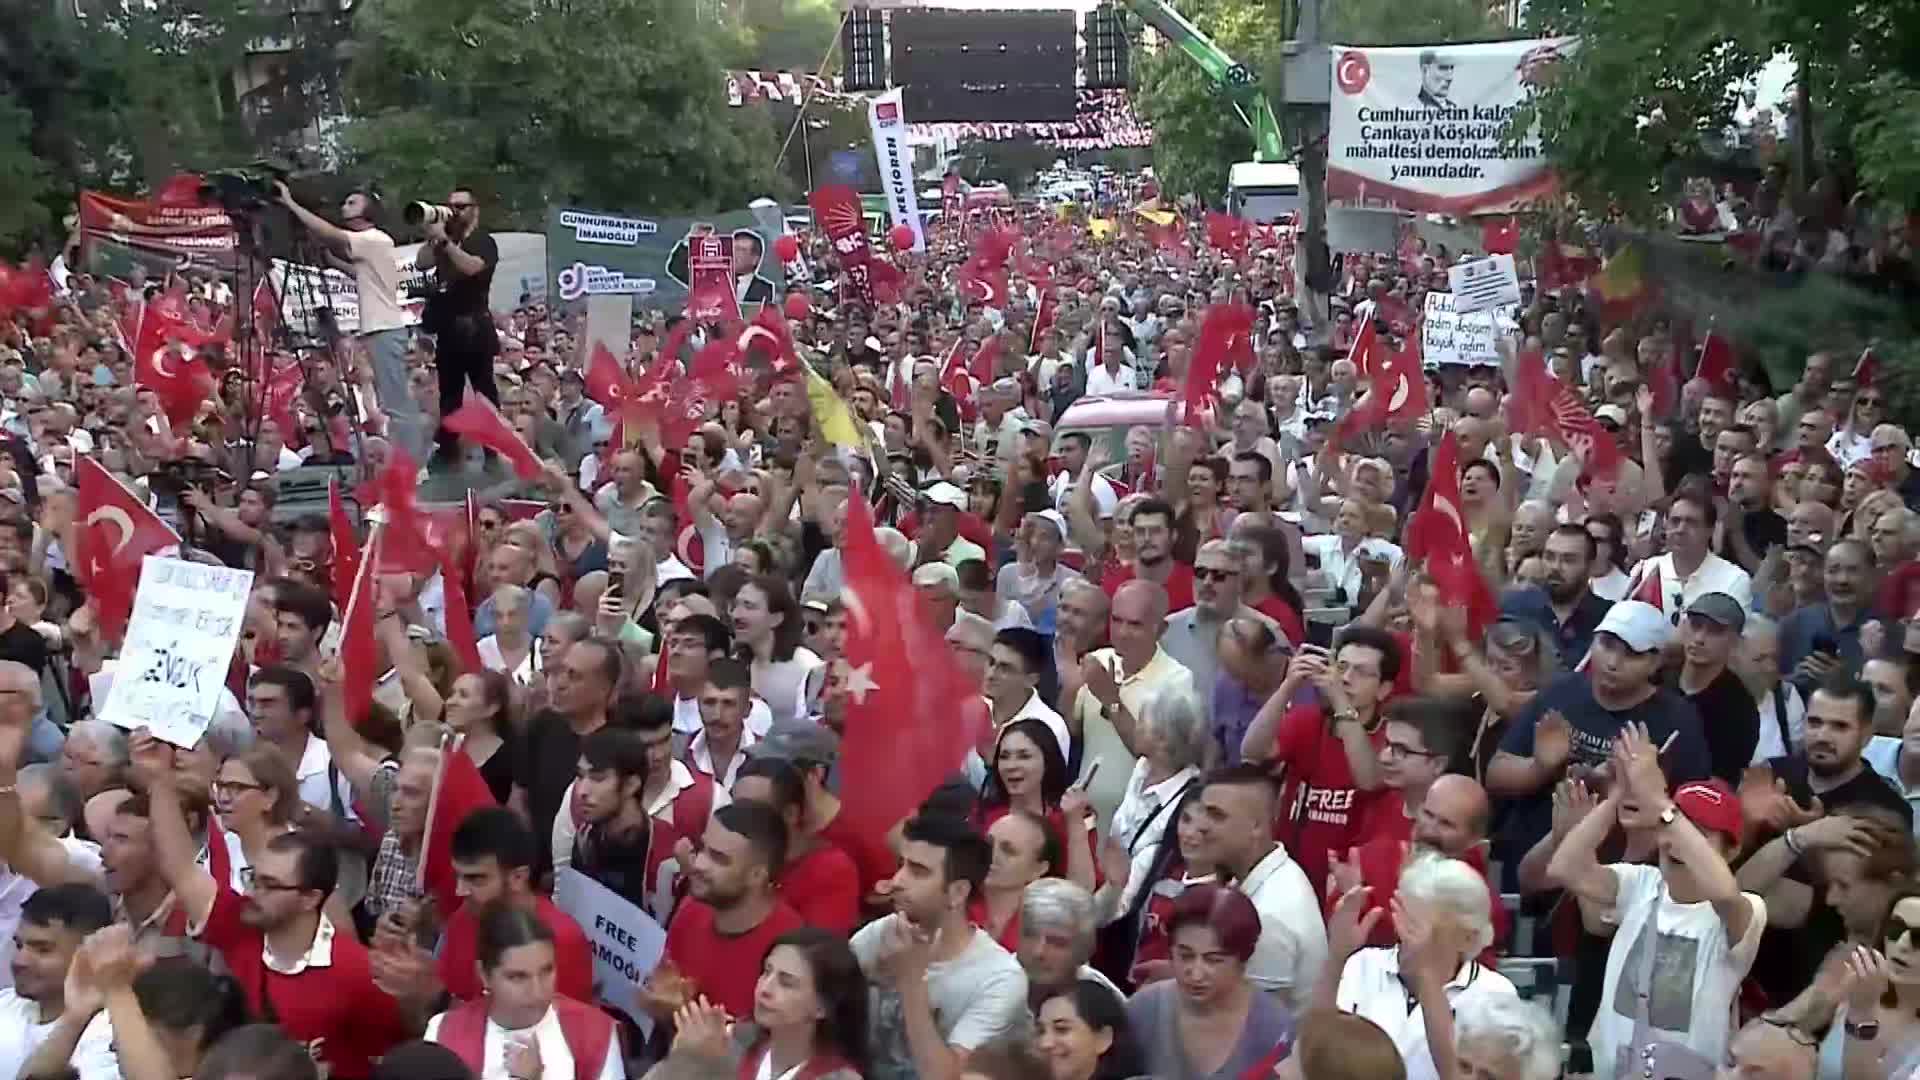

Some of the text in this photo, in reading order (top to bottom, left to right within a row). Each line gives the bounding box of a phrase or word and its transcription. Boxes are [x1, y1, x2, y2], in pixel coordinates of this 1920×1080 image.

[1473, 103, 1519, 121] kale
[1361, 124, 1430, 144] Çankaya
[1345, 143, 1422, 158] mahallesi
[1390, 162, 1485, 180] yanındadır.
[595, 914, 639, 953] FREE
